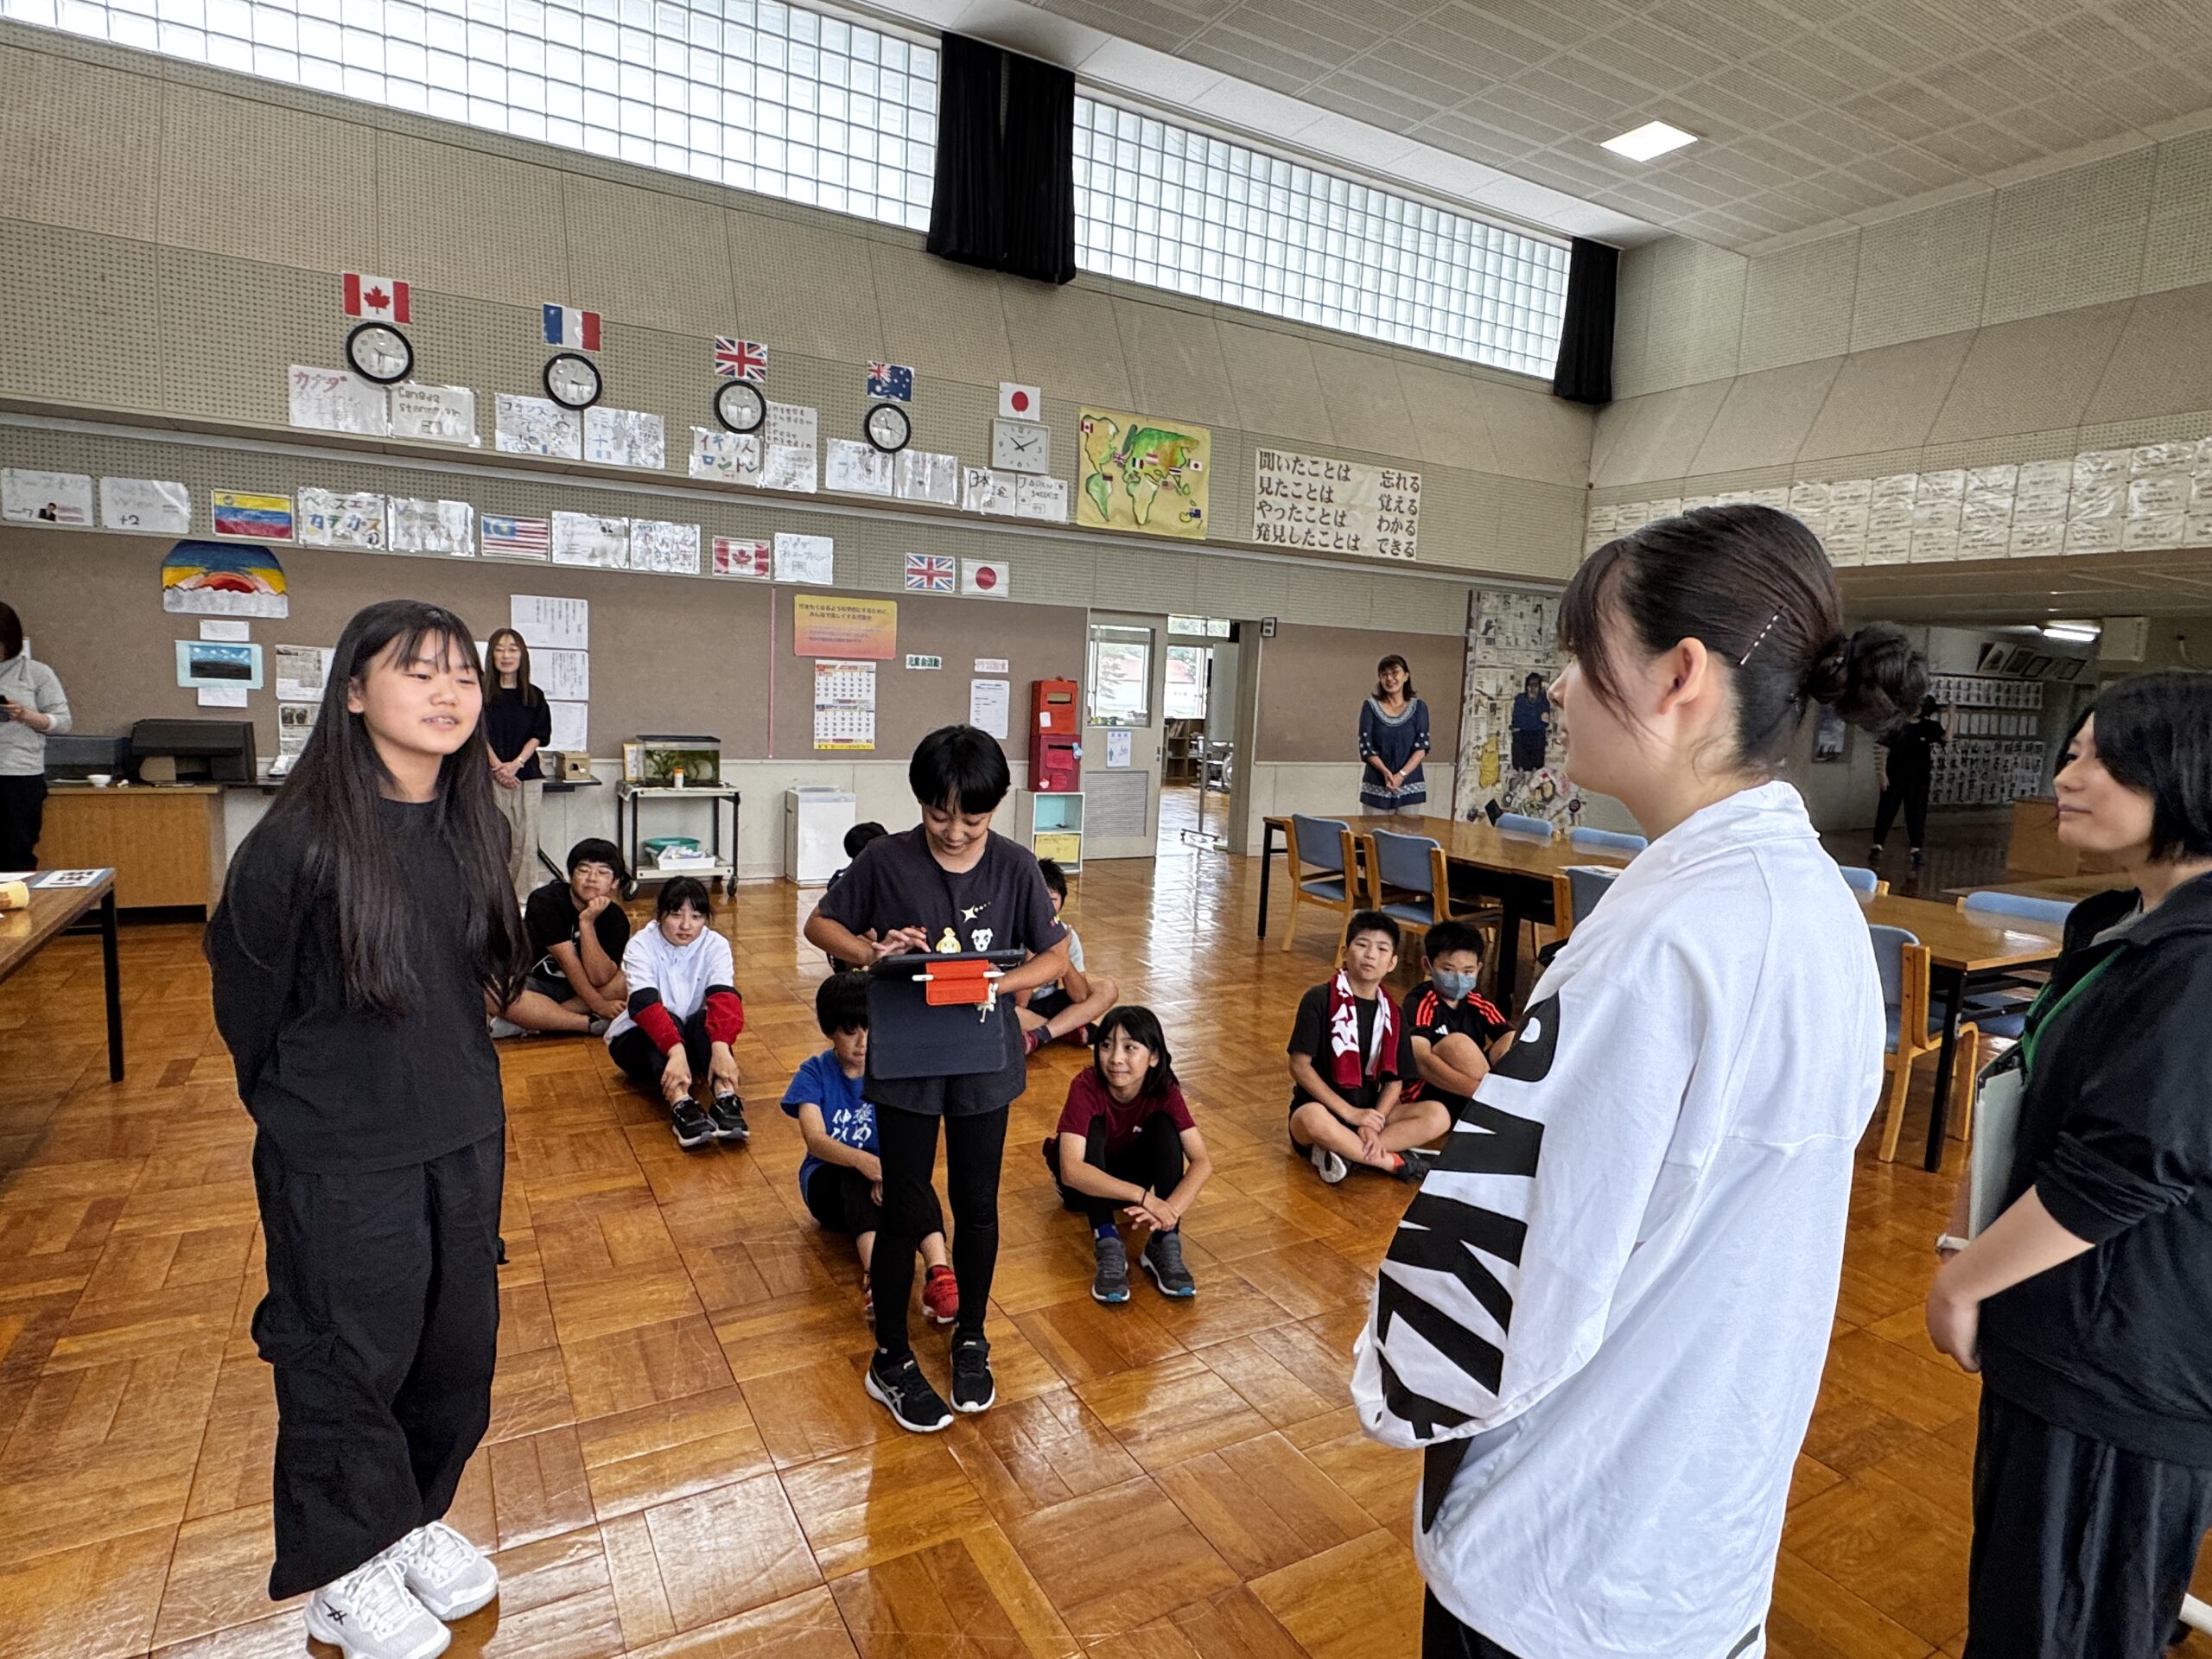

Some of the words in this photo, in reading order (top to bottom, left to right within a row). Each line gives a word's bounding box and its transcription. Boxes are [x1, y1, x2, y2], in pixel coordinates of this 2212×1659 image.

[1258, 450, 1351, 482] 聞いたことは
[1379, 470, 1421, 493] 忘れる
[1258, 475, 1334, 504] 見たことは
[1378, 493, 1418, 515] 覚える
[1256, 499, 1347, 528] やったことは
[1376, 516, 1416, 537] わかる
[1255, 524, 1360, 552] 発見したことは
[1376, 537, 1415, 558] できる
